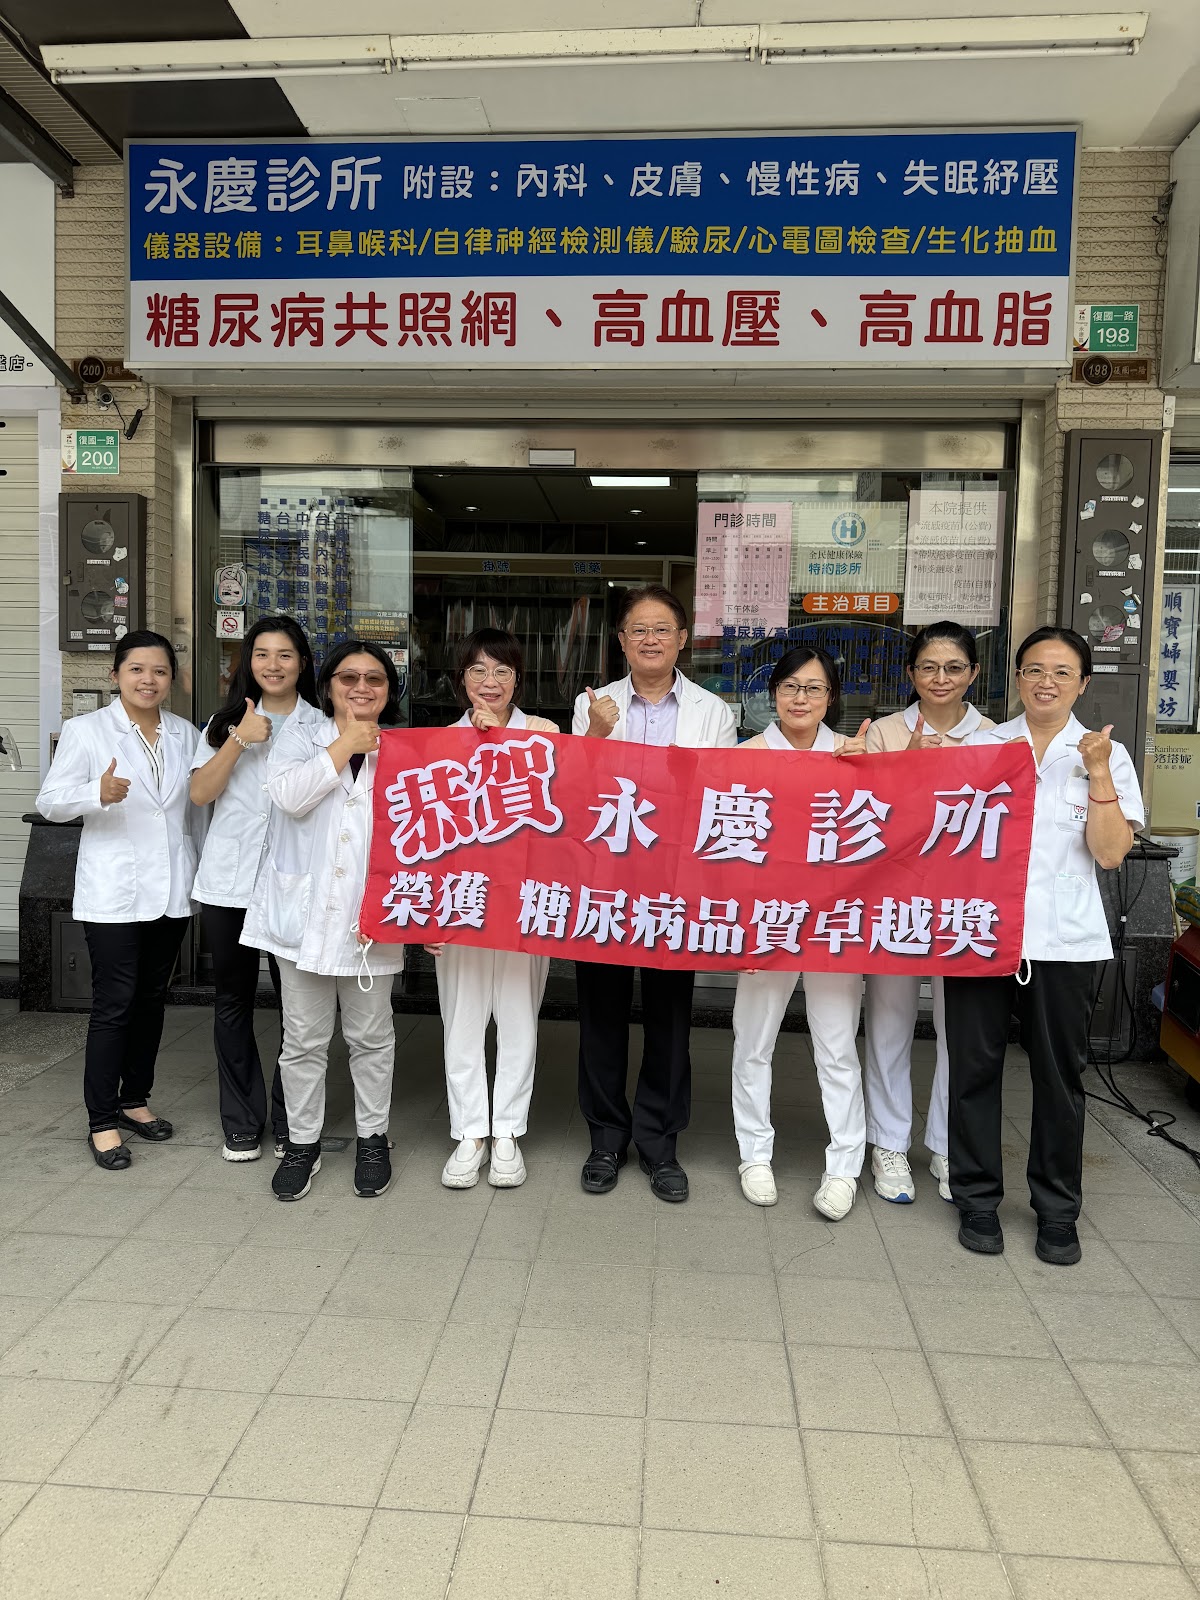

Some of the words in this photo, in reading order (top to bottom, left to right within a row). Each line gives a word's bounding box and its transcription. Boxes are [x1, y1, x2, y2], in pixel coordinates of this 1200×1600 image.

[143, 155, 383, 214] 永慶診所
[146, 289, 1053, 347] 糖尿病共照網、高血壓、高血脂
[1092, 311, 1134, 322] 復國一路
[1097, 327, 1130, 344] 198
[82, 365, 101, 376] 200
[1088, 364, 1108, 376] 198
[79, 435, 115, 445] 復國一路
[81, 451, 114, 466] 200
[928, 501, 987, 516] 本院提供
[714, 513, 777, 528] 門診時間
[808, 550, 863, 560] 全民健康保險
[482, 559, 511, 573] 掛號
[573, 561, 602, 574] 領藥
[808, 562, 861, 576] 特約診所
[297, 512, 310, 640] 中華民國超音波
[725, 604, 759, 614] 下午休診
[812, 595, 890, 612] 主治項目
[1154, 745, 1188, 754] Karihome
[385, 735, 563, 866] 恭賀
[583, 775, 1013, 865] 永慶診所
[380, 870, 491, 929] 榮獲
[517, 878, 1000, 957] 糖尿病品質卓越獎
